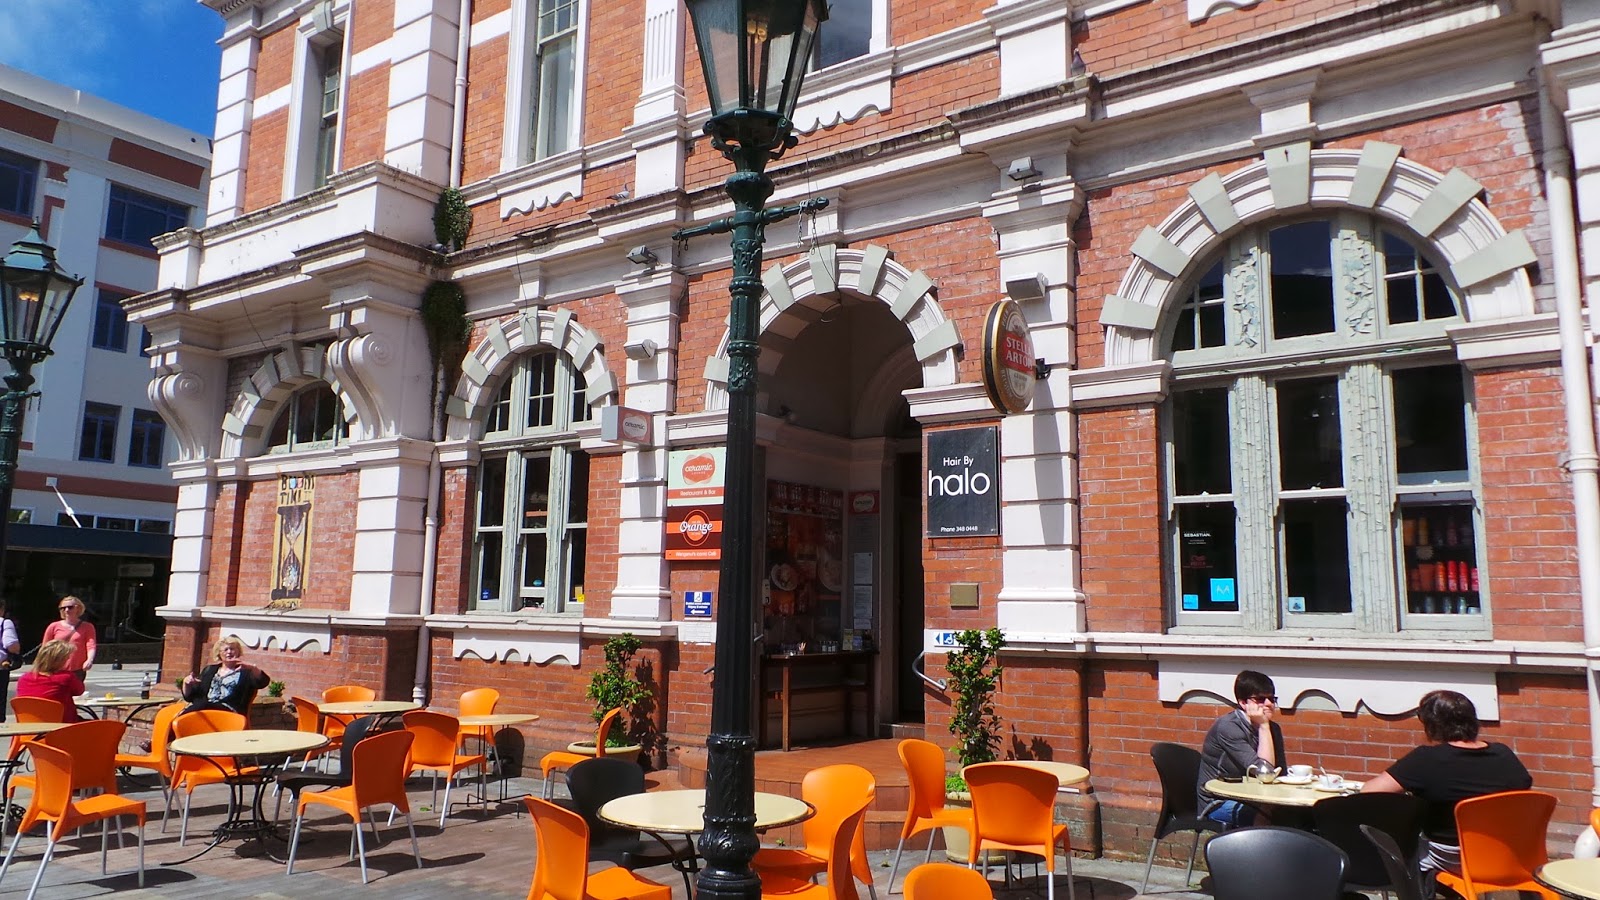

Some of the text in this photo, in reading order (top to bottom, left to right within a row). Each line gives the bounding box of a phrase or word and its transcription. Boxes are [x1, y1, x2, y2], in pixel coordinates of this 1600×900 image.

[1005, 336, 1032, 357] STELLA
[624, 420, 645, 430] ceramic
[684, 463, 713, 472] ceramic
[943, 455, 974, 467] Hair By
[928, 467, 991, 497] halo
[680, 521, 713, 535] Orange
